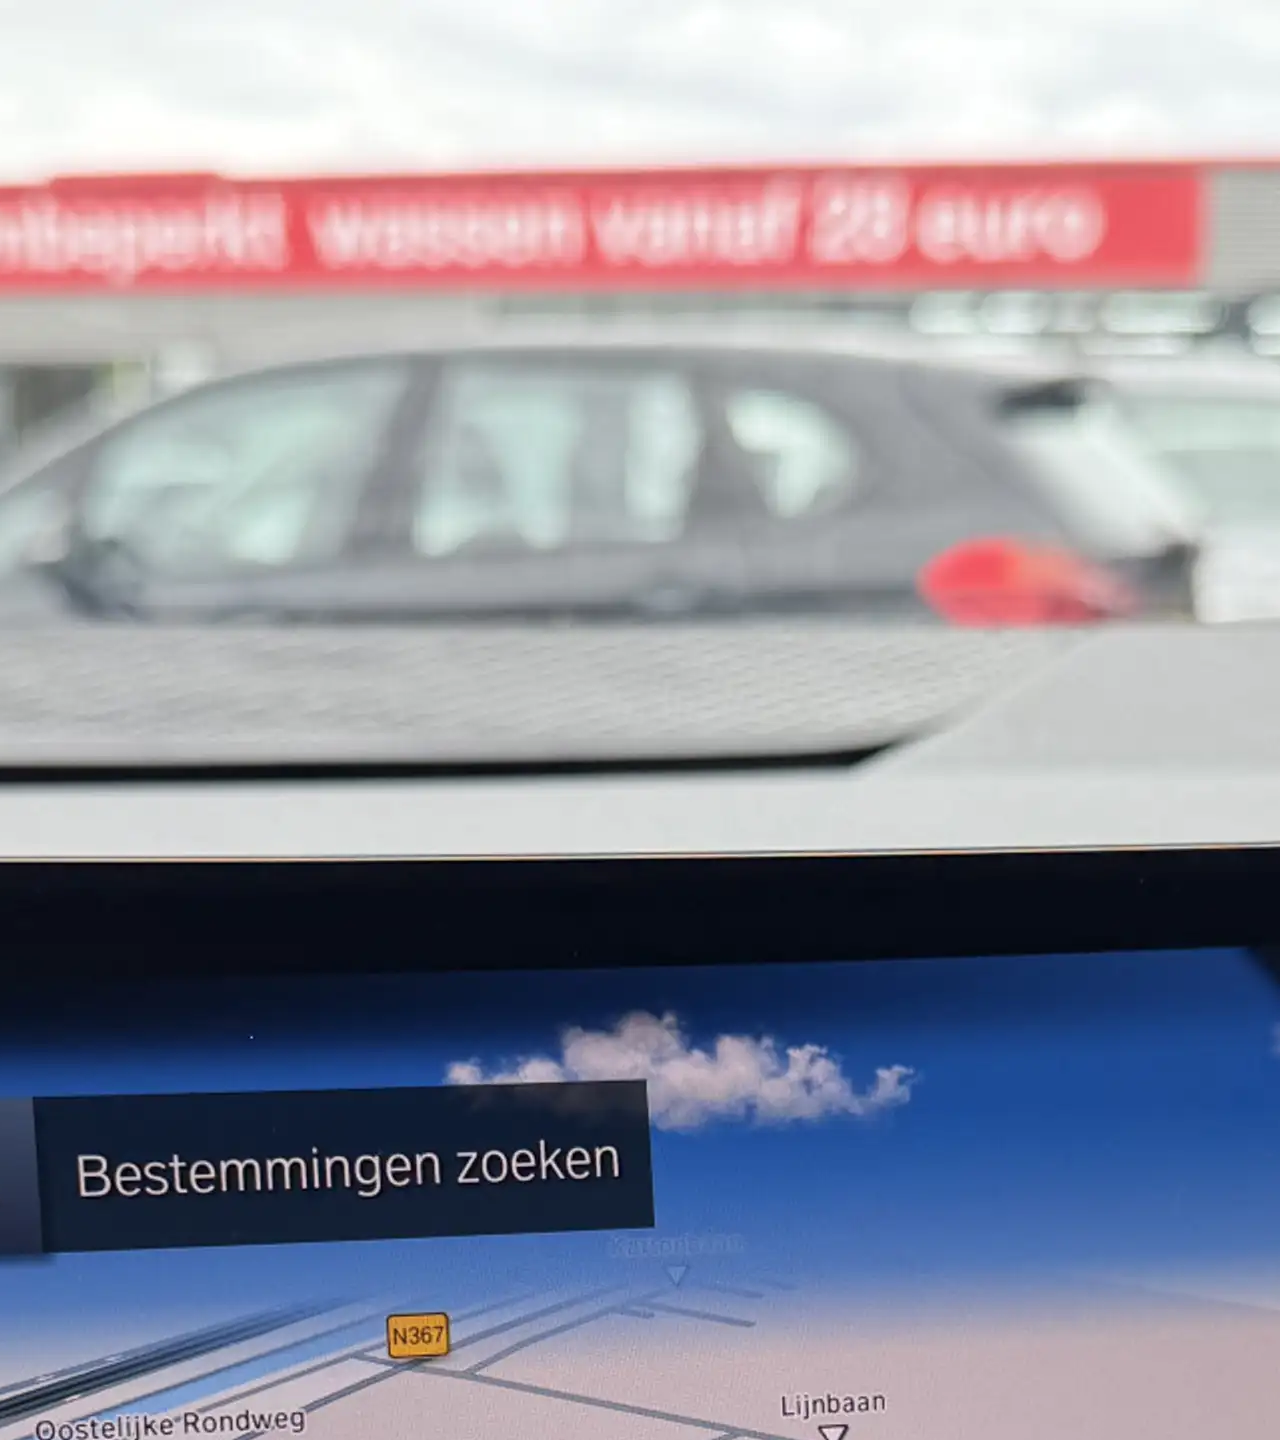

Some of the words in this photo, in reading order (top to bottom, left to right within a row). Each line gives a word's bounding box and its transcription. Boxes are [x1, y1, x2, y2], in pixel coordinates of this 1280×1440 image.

[312, 196, 584, 274] wassen
[594, 180, 798, 268] vanaf
[916, 184, 1108, 266] euro
[77, 1147, 441, 1197] Bestemmingen
[457, 1140, 620, 1185] zoeken
[393, 1325, 444, 1348] N367
[781, 1392, 886, 1420] Lijnbaan
[184, 1408, 305, 1438] Rondweg
